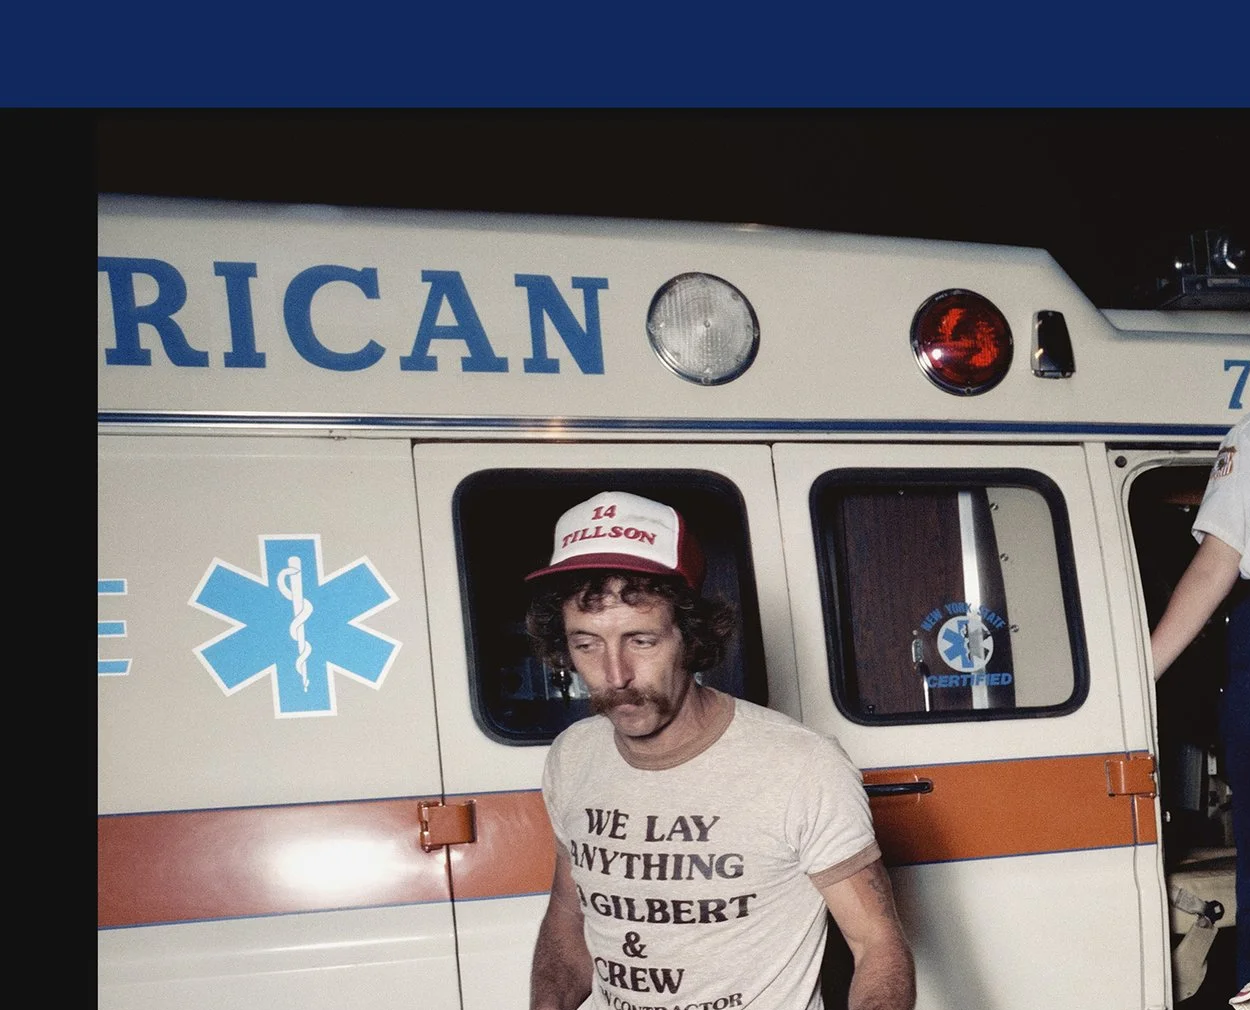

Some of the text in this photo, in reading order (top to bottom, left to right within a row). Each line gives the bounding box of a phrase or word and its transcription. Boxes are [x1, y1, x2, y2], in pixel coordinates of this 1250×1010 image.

[98, 256, 609, 374] RICAN
[591, 504, 617, 521] 14
[562, 525, 657, 549] TILLSON
[920, 608, 943, 632] NEW
[944, 602, 972, 615] YORK
[927, 673, 1013, 688] CERTIFIED
[585, 808, 721, 842] WE LAY
[570, 839, 744, 881] ANYTHING
[590, 892, 757, 925] GILBERT
[622, 931, 648, 959] &
[594, 956, 685, 994] CREW
